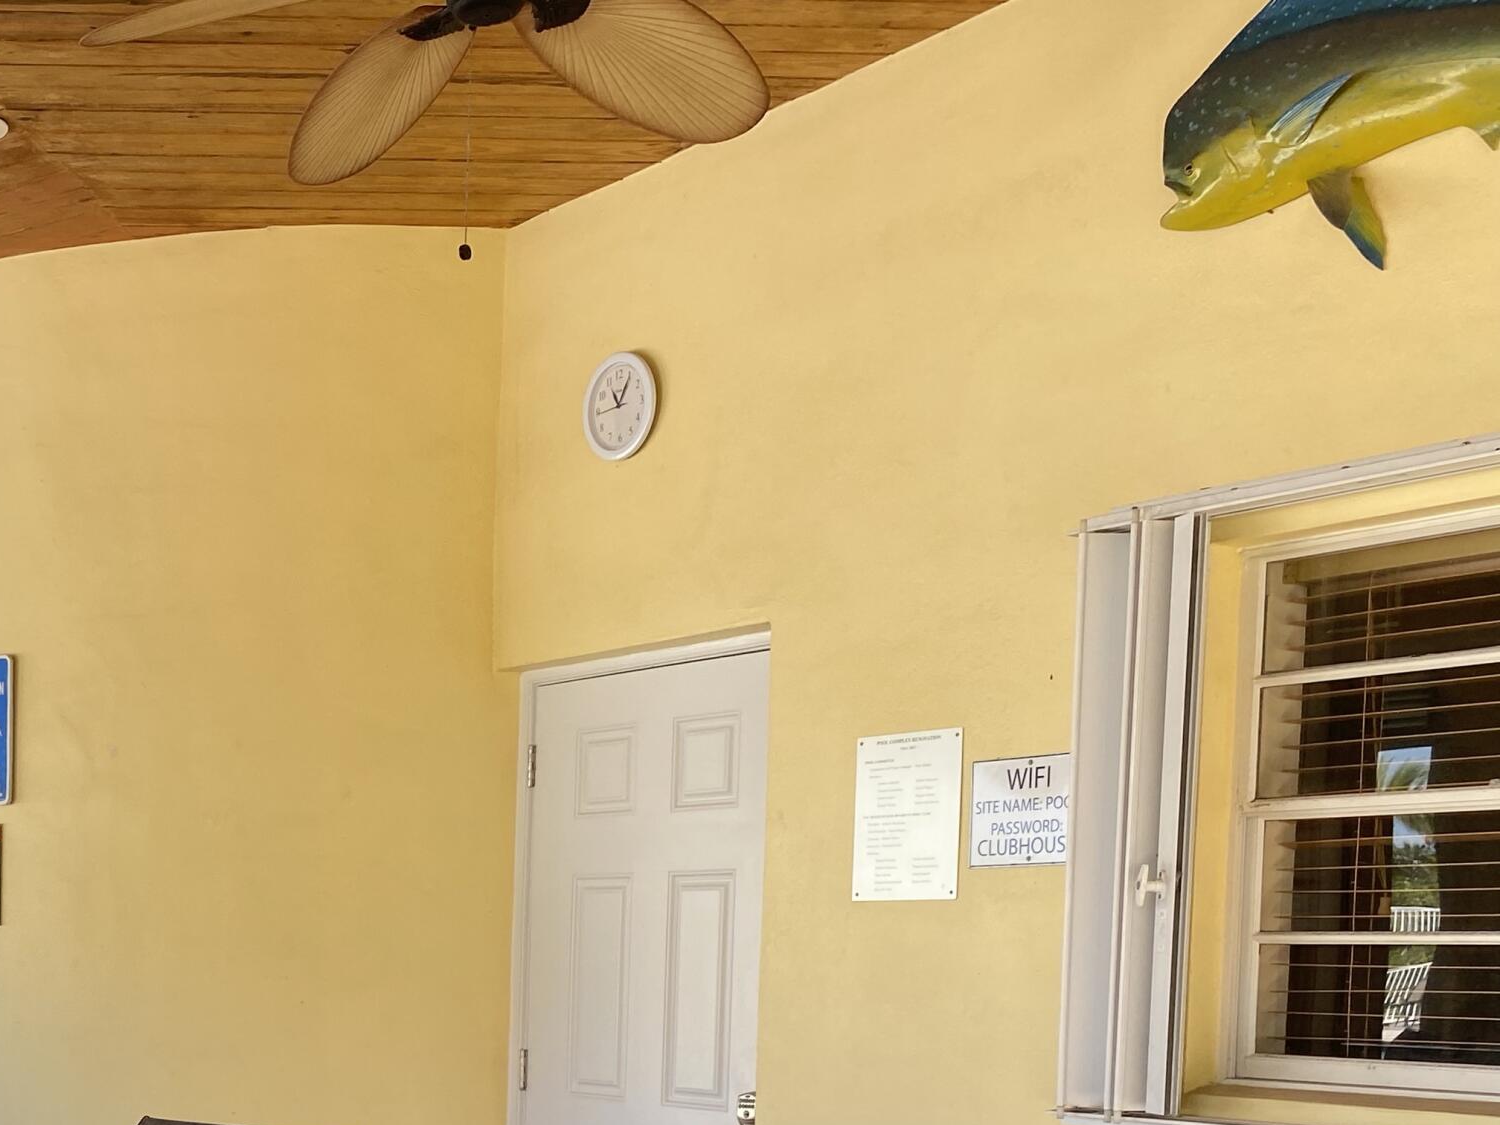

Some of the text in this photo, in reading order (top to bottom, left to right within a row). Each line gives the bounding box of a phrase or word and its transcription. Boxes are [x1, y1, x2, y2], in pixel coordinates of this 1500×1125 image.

[615, 369, 623, 380] 12
[975, 800, 1000, 815] SITE
[1002, 797, 1043, 813] NAME:
[991, 819, 1063, 836] PASSWORD:
[977, 835, 1066, 857] CLUBHOUS
